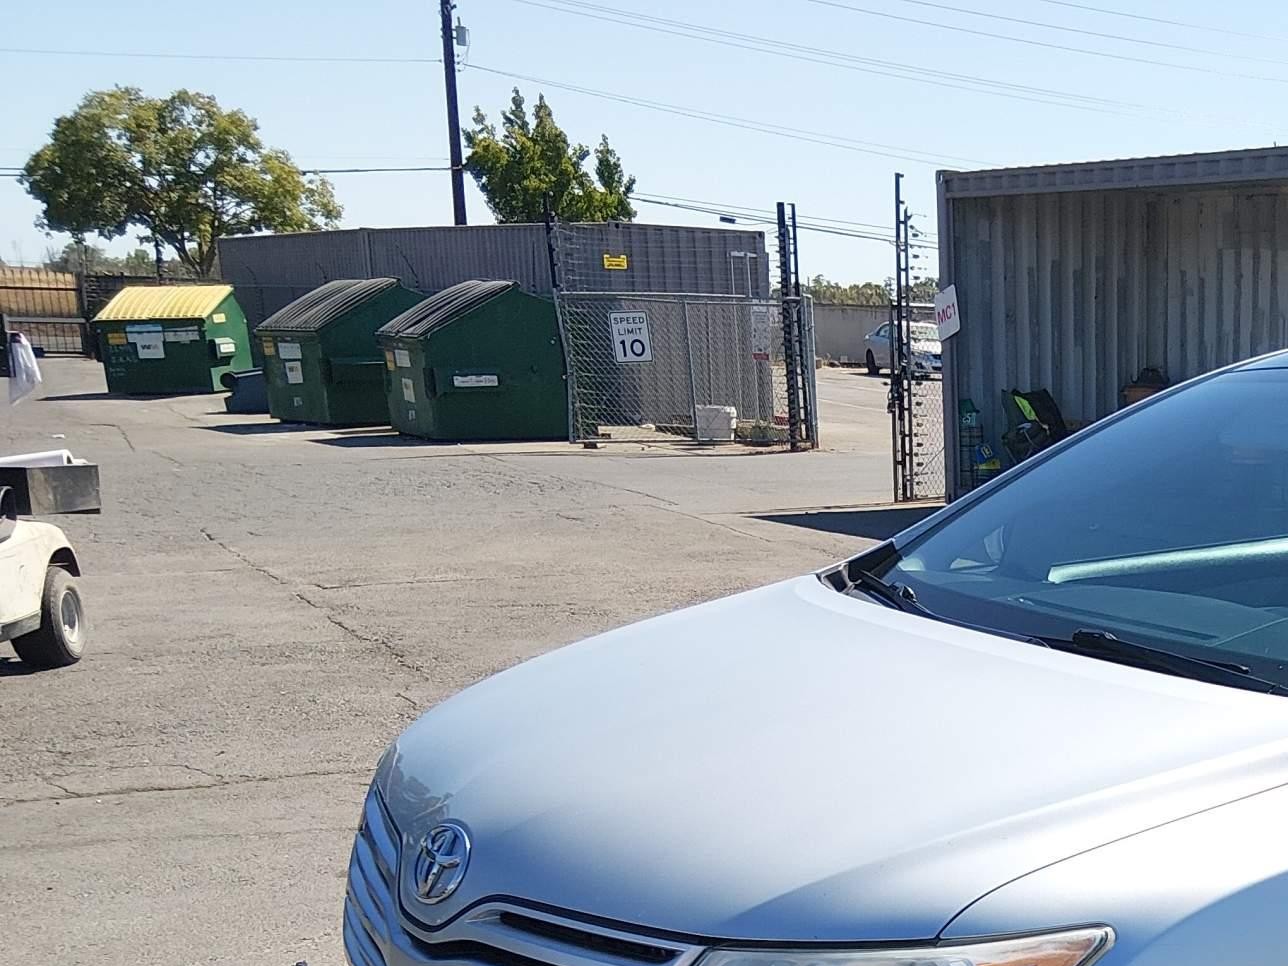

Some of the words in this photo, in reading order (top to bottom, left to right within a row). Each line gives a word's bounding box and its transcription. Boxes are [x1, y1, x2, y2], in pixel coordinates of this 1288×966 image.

[937, 302, 957, 324] MC1
[613, 316, 645, 325] SPEED
[617, 327, 643, 336] LIMIT
[620, 339, 646, 358] 10
